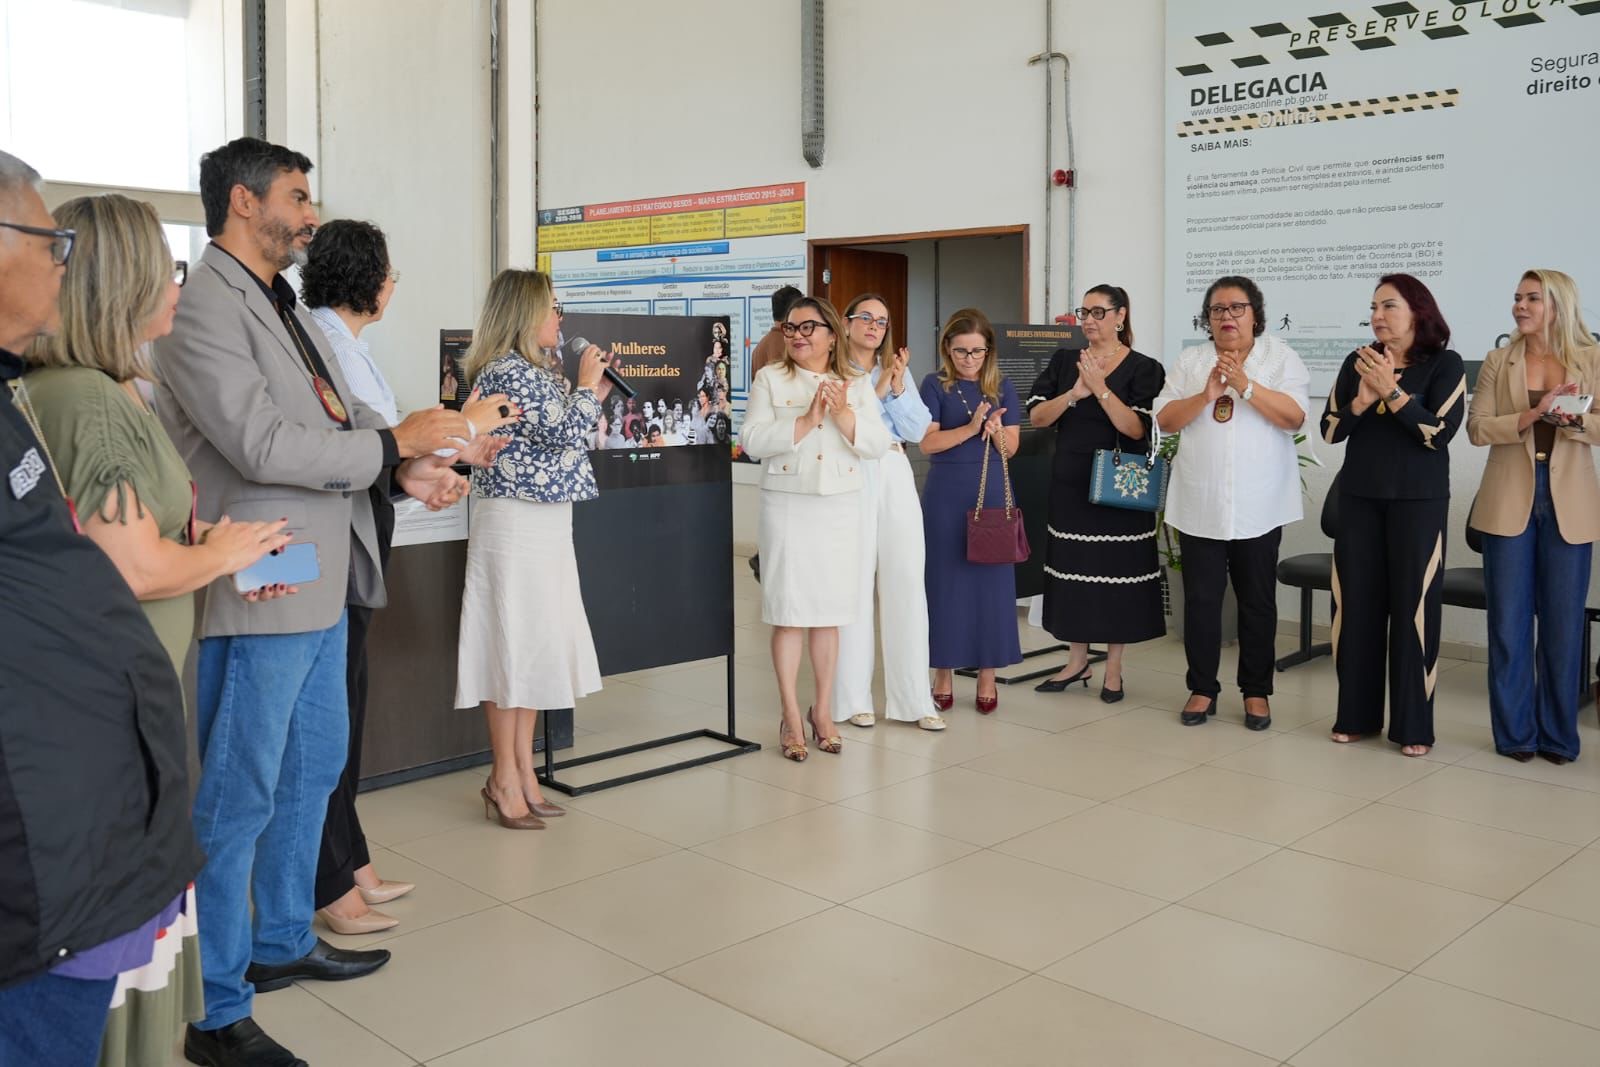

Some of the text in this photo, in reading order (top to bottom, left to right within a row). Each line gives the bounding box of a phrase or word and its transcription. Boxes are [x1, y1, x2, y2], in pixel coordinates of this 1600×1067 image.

[1290, 10, 1439, 48] PRESERVE
[1452, 6, 1467, 22] O
[1191, 72, 1328, 107] DELEGACIA
[1527, 75, 1591, 95] direito
[1190, 92, 1328, 117] www.delegaciaonline.pb.gov.br
[1259, 109, 1318, 128] Online
[1191, 138, 1252, 153] SAIBA MAIS:
[1211, 171, 1247, 179] ferramenta
[1323, 162, 1351, 170] permite
[1372, 155, 1422, 166] ocorrências
[1303, 172, 1330, 182] simples
[1382, 166, 1403, 174] ainda
[1405, 162, 1444, 172] acidentes
[1196, 190, 1221, 198] trânsito
[1301, 180, 1341, 190] registradas
[1344, 179, 1359, 187] pela
[589, 205, 632, 216] PLANEJAMENTO
[633, 200, 673, 212] ESTRATÉGICO
[698, 196, 716, 205] MAPA
[716, 191, 760, 204] ESTRATÉGICO
[1250, 212, 1292, 220] comodidade
[1368, 205, 1396, 214] precisa
[1409, 201, 1444, 209] deslocar
[1241, 222, 1264, 230] policial
[1235, 248, 1269, 256] disponível
[1326, 253, 1353, 261] Boletim
[1369, 250, 1411, 259] Ocorrência
[1415, 249, 1434, 257] (BO)
[1268, 264, 1303, 272] Delegacia
[1334, 263, 1347, 271] que
[1350, 261, 1377, 269] analisa
[1380, 260, 1403, 268] dados
[1406, 258, 1442, 268] pessoais
[1283, 273, 1317, 282] descrição
[1429, 269, 1442, 277] por
[611, 342, 667, 355] Mulheres
[620, 364, 681, 377] sibilizadas
